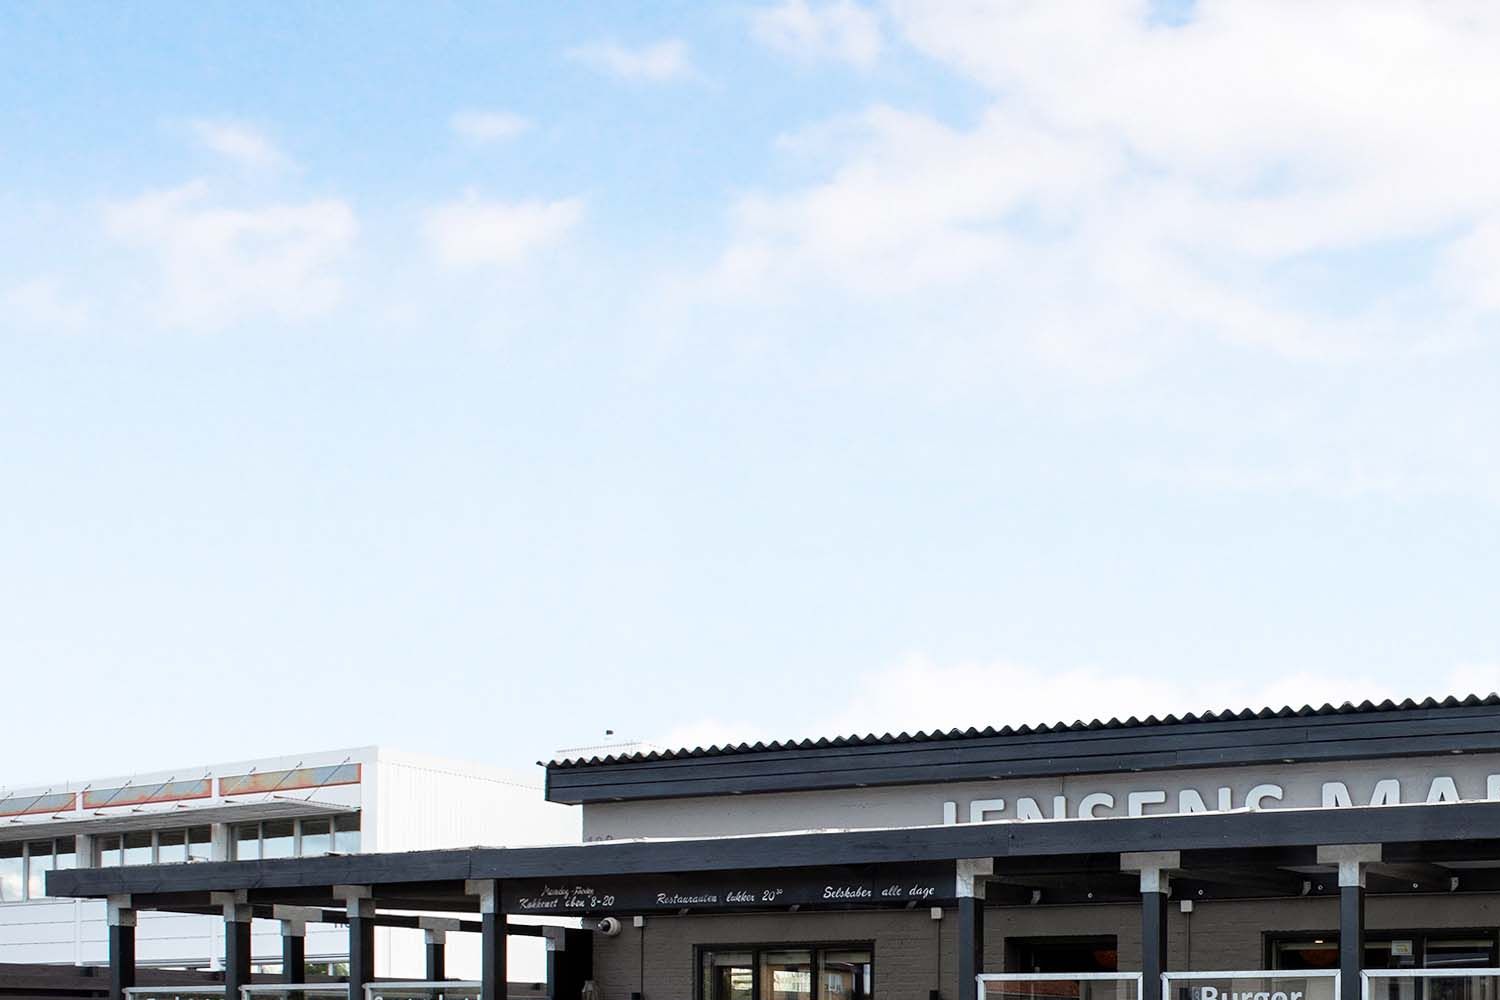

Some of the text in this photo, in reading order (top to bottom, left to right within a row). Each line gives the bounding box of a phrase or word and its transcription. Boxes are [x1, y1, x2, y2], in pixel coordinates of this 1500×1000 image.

[726, 890, 755, 903] lukker
[823, 884, 935, 899] Selskaber alle dage
[590, 895, 615, 908] 8-20
